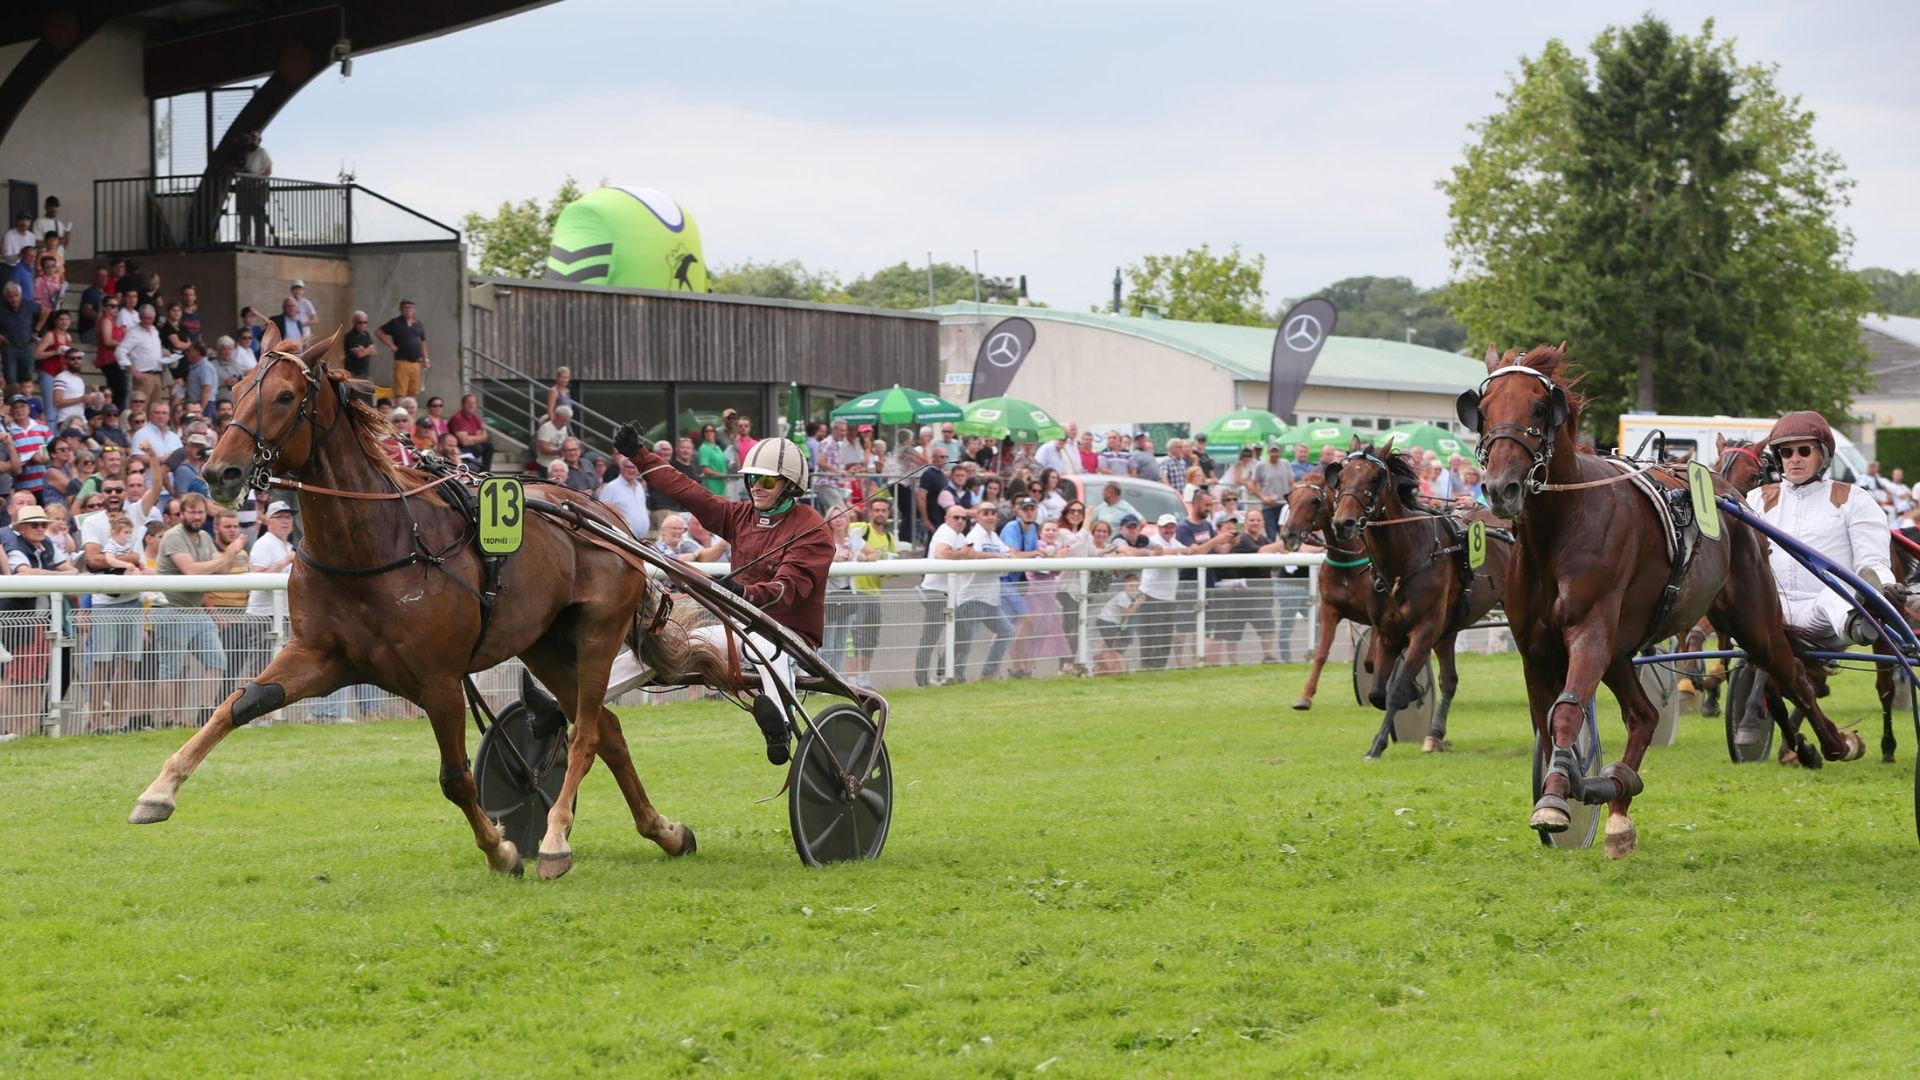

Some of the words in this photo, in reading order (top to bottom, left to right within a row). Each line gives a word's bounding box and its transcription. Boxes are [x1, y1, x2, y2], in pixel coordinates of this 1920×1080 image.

[484, 482, 519, 527] 13
[1695, 468, 1707, 513] 1
[483, 536, 508, 545] TROPHÉE
[1474, 523, 1481, 552] 8
